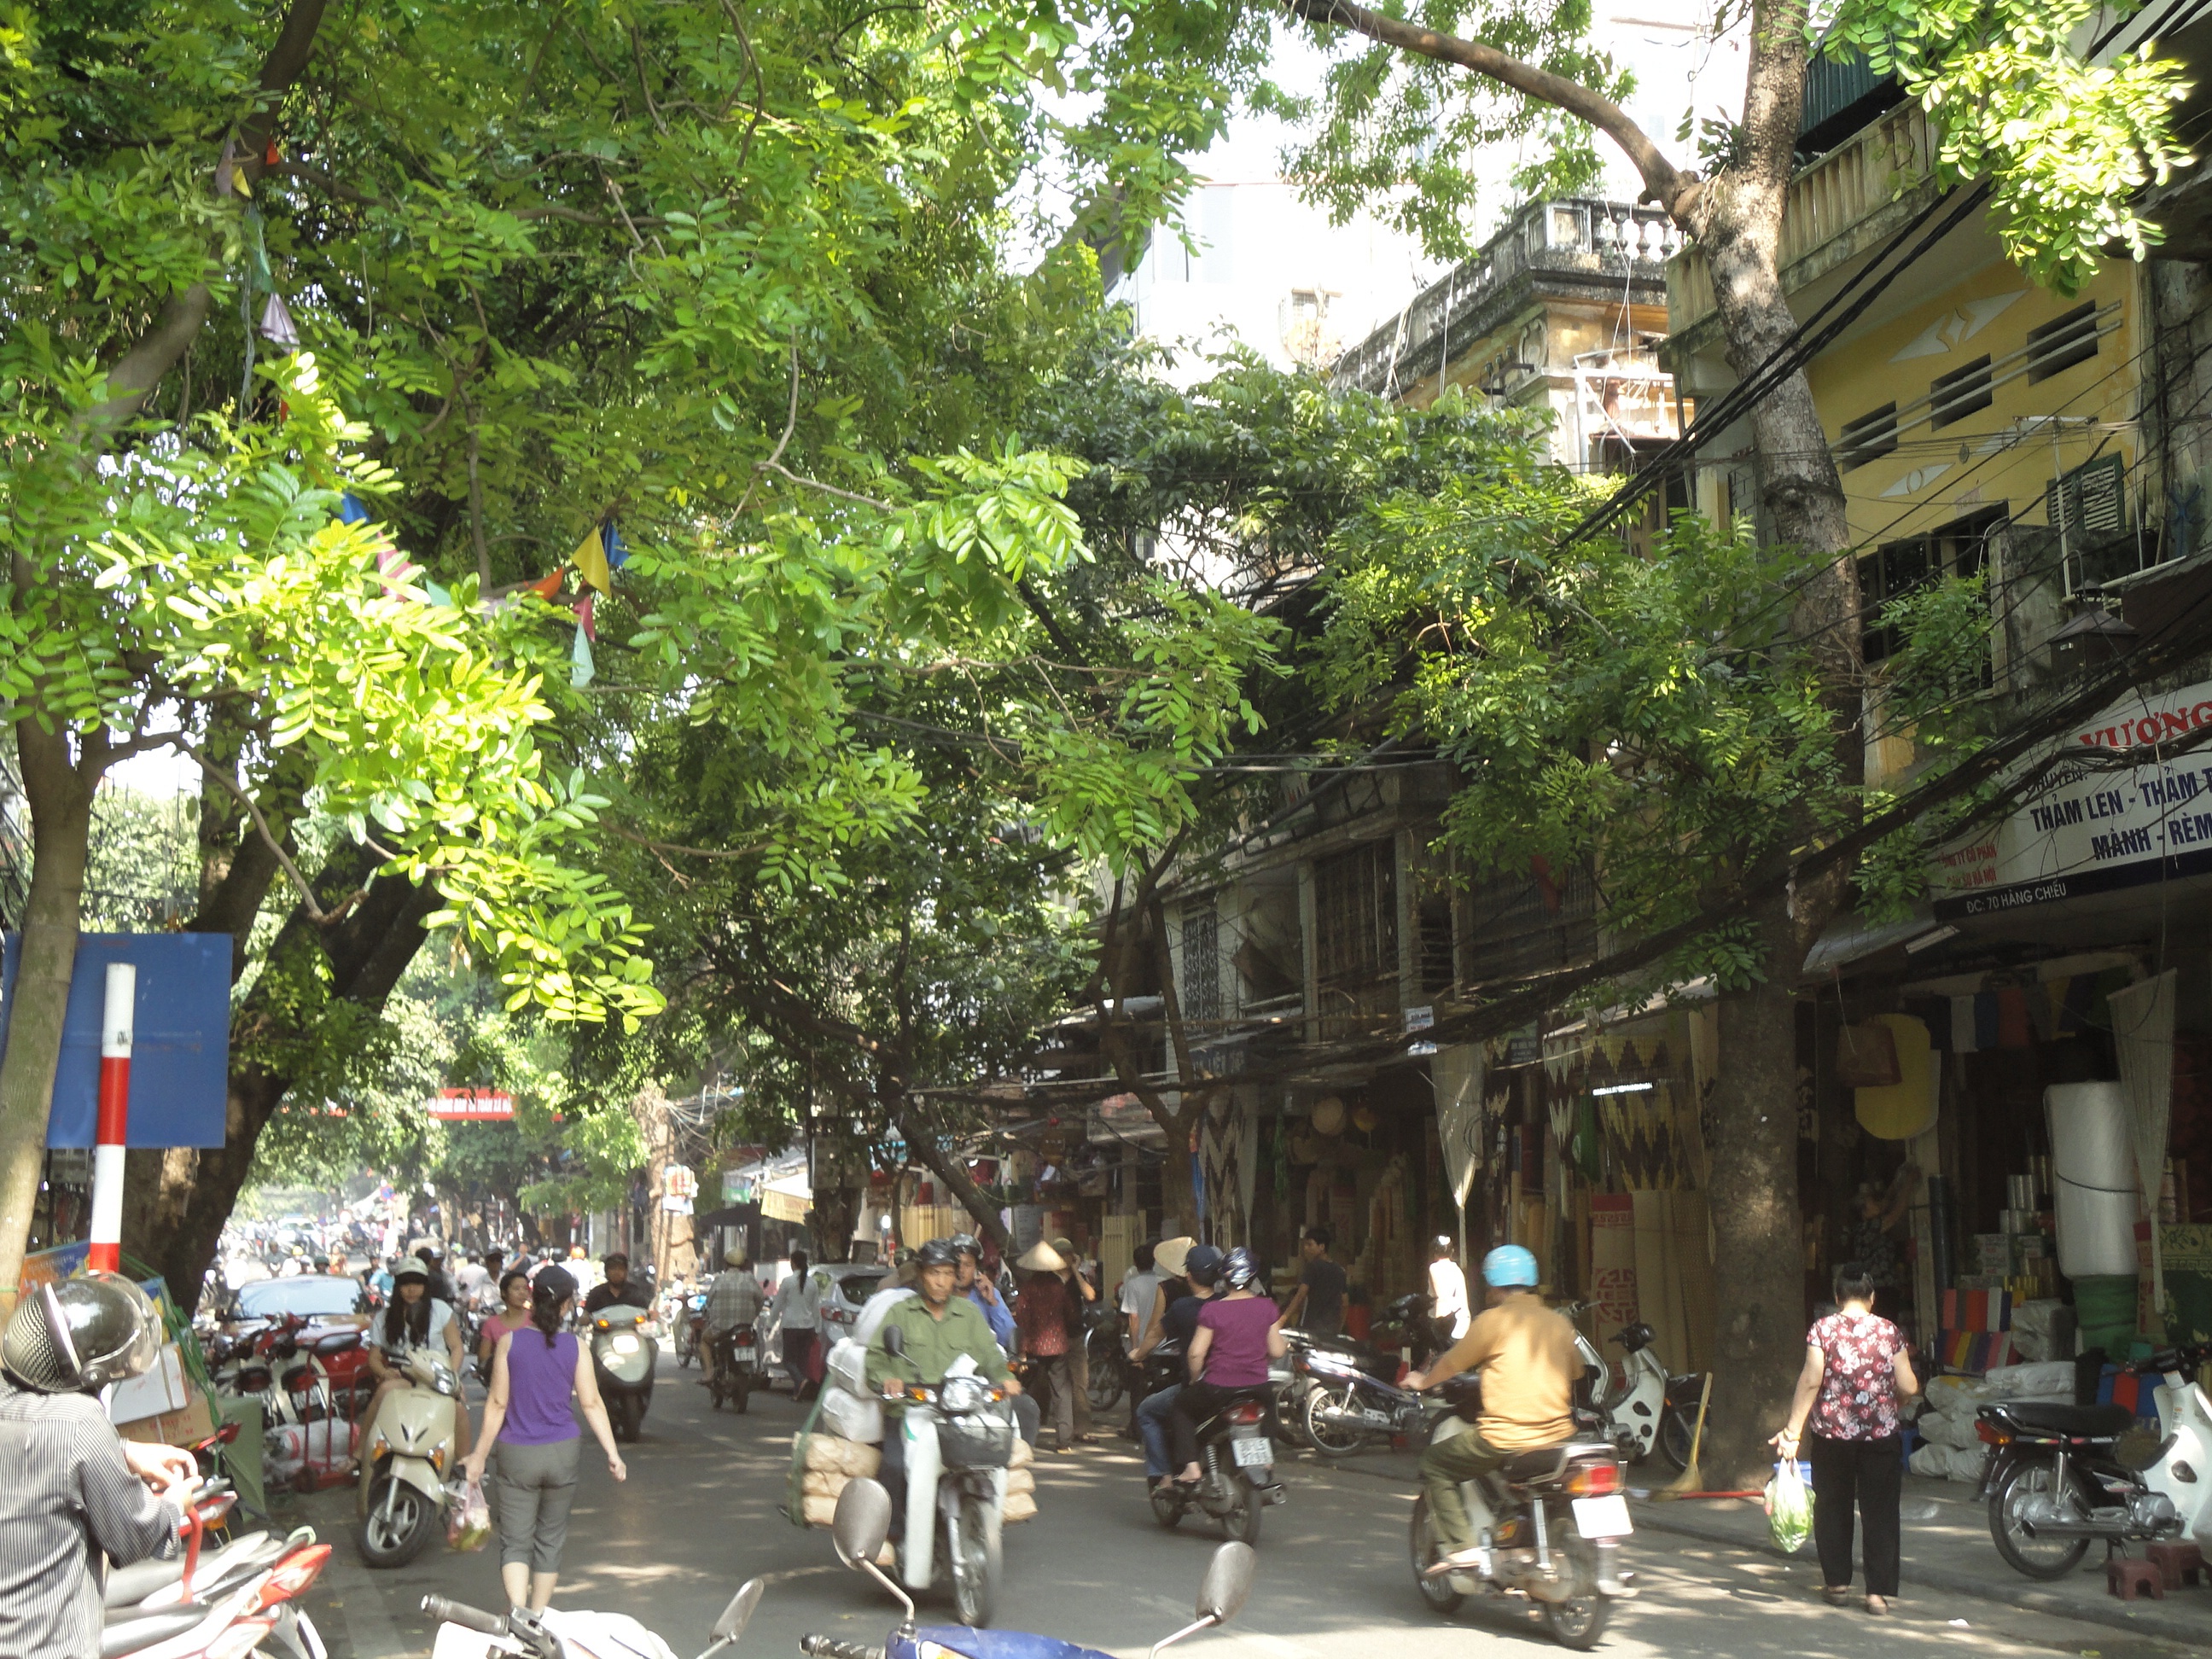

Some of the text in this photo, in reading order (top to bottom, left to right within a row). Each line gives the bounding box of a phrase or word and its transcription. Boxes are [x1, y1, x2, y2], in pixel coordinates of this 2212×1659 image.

[2079, 701, 2212, 747] VƯƠNG
[2029, 793, 2084, 833] THẢM
[2085, 789, 2124, 820] LEN
[2139, 765, 2199, 807] THẢM
[2168, 812, 2212, 846] RÈM
[1966, 879, 2067, 913] ĐC: 70 HÀNG CHIẾU
